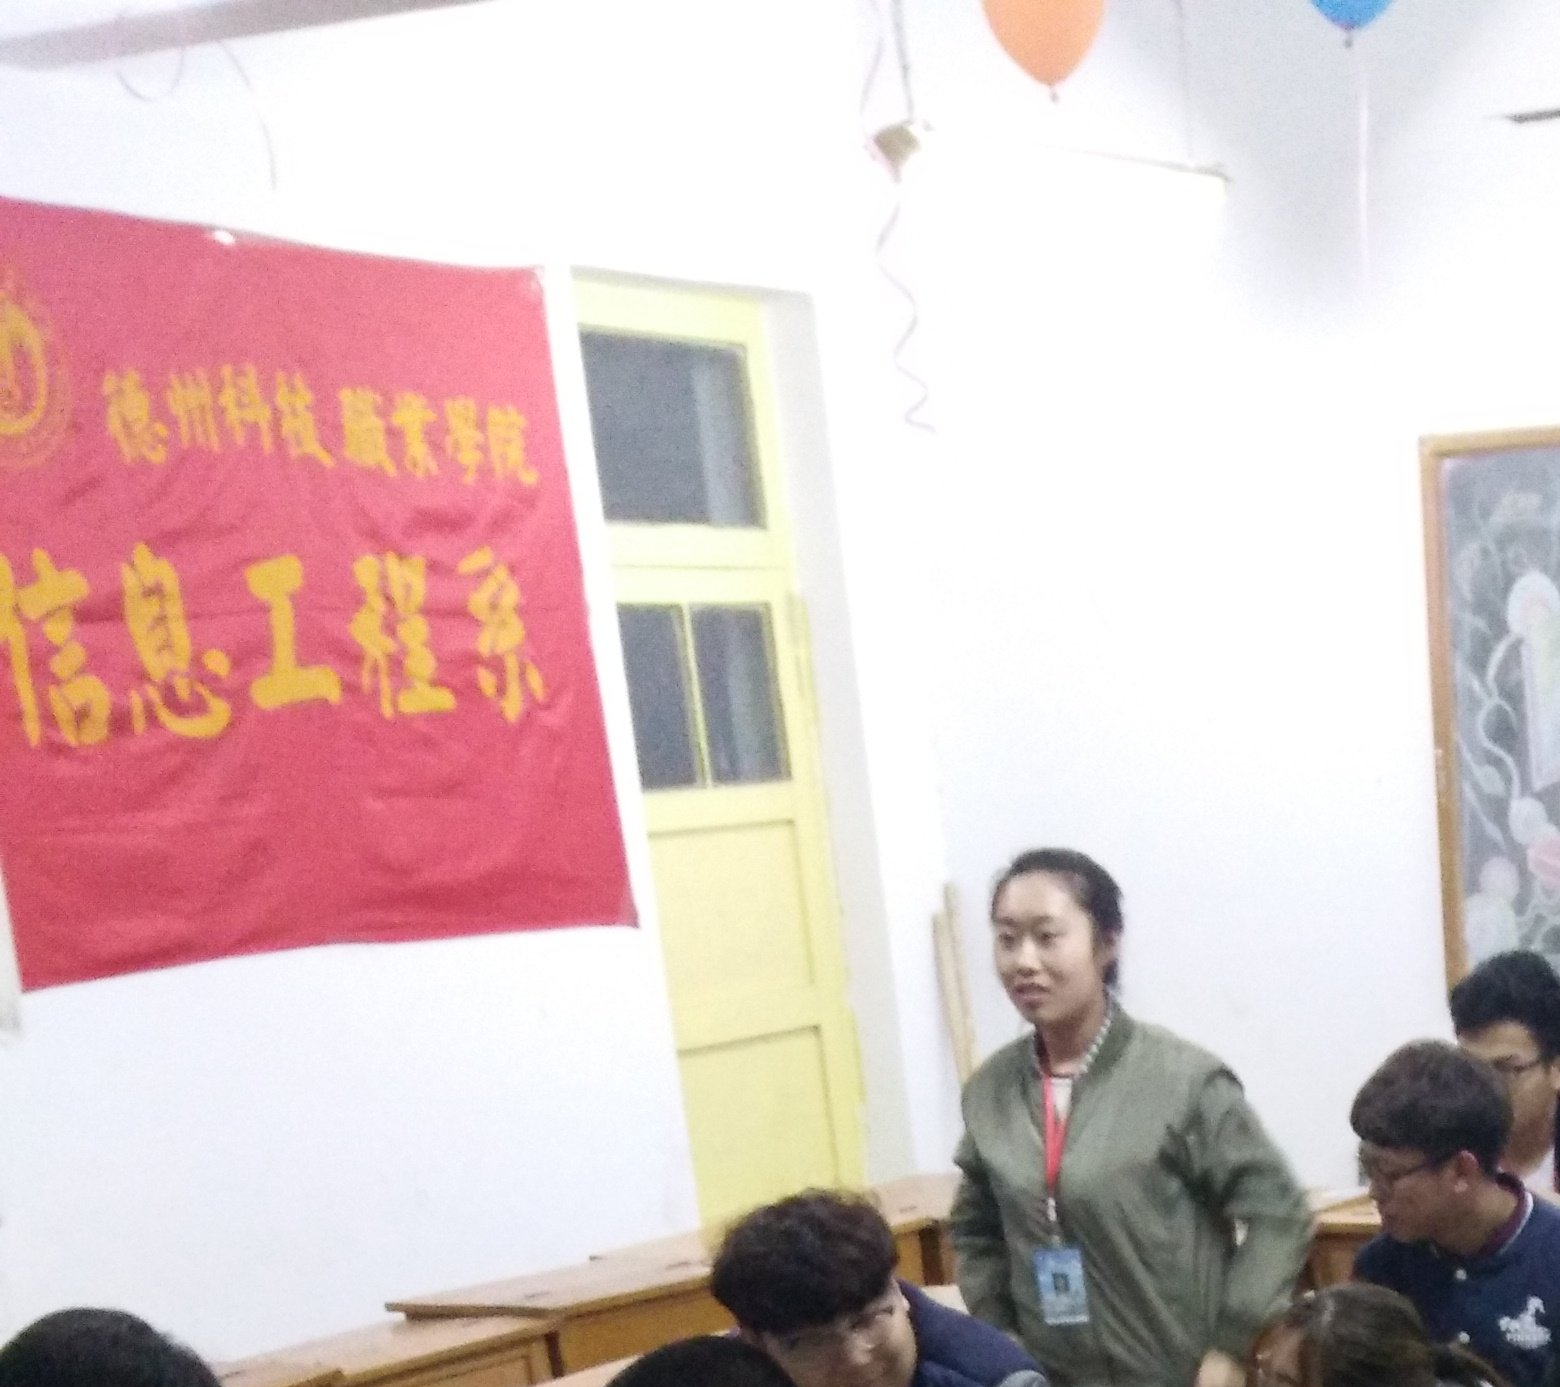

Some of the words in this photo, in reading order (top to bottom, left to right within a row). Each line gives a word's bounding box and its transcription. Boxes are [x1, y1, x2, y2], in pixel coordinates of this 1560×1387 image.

[0, 541, 547, 748] 信息工程系
